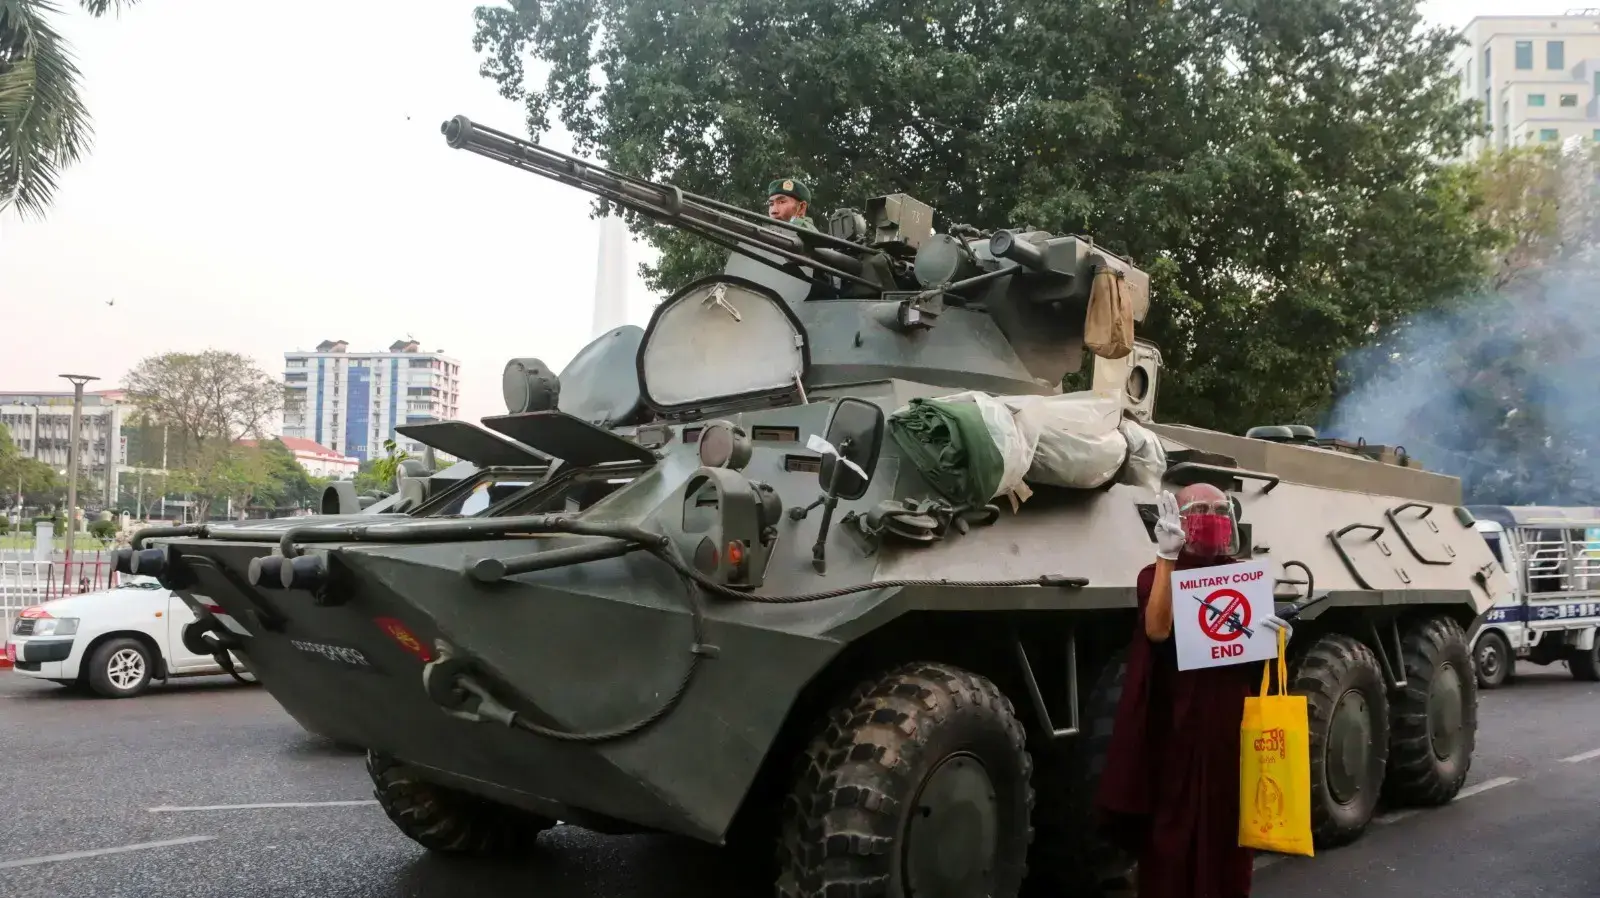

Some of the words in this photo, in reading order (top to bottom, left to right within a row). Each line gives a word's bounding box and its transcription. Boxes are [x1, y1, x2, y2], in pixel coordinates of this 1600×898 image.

[1179, 575, 1229, 590] MILITARY
[1232, 570, 1264, 583] COUP
[1211, 643, 1244, 660] END
